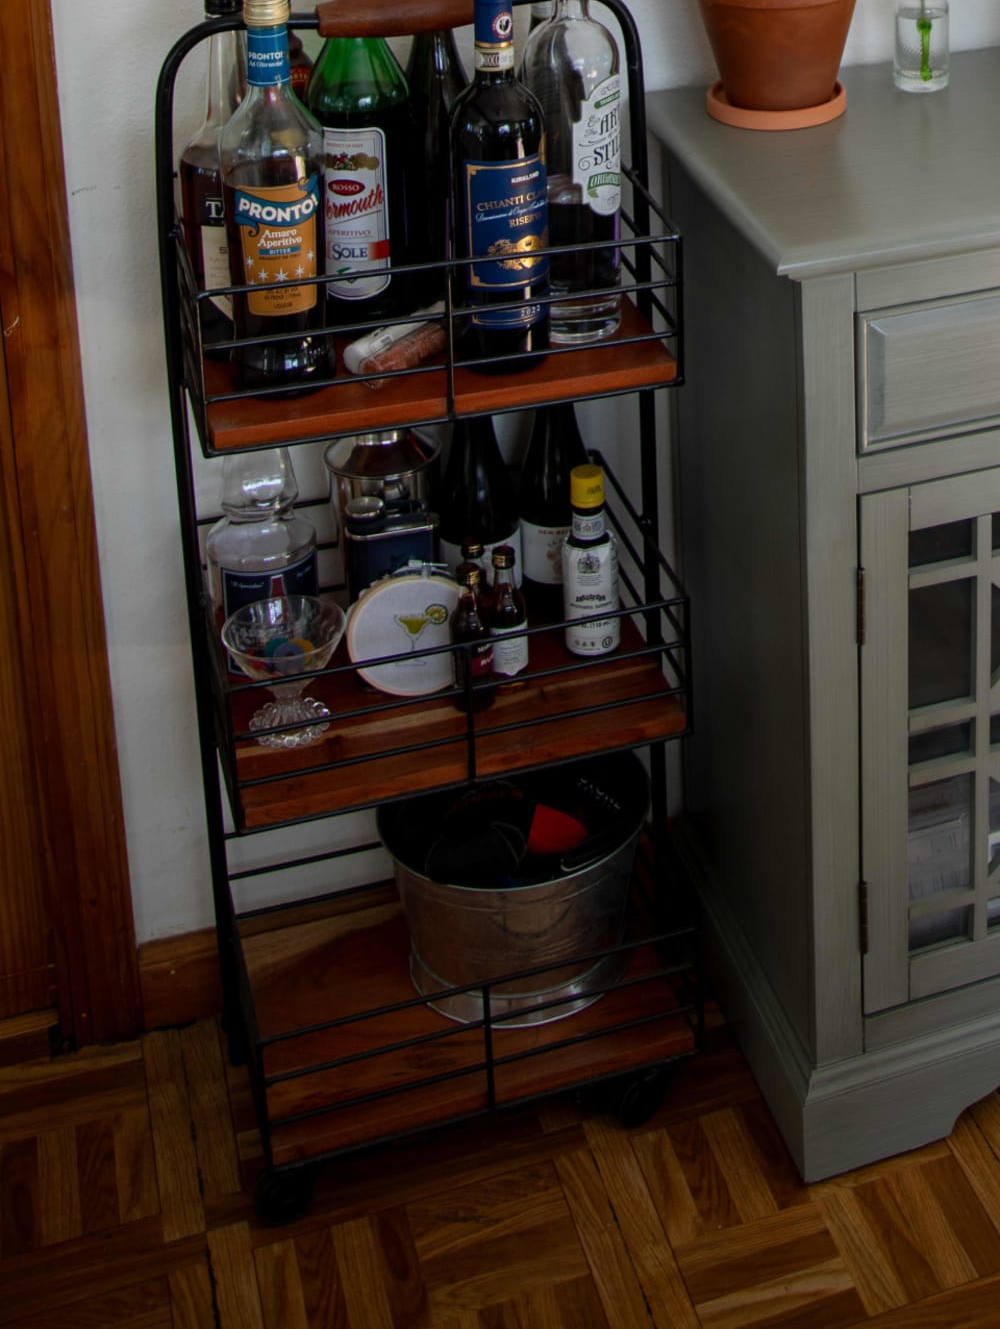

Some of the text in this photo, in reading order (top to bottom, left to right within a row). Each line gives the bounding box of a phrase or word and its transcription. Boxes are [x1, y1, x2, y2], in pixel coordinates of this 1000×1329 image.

[248, 50, 283, 60] PRONTO!
[238, 193, 318, 222] PRONTO!
[477, 194, 524, 211] CHIANTI
[262, 229, 297, 239] Amaro
[257, 235, 302, 248] Aperitivo
[521, 304, 540, 317] 2022
